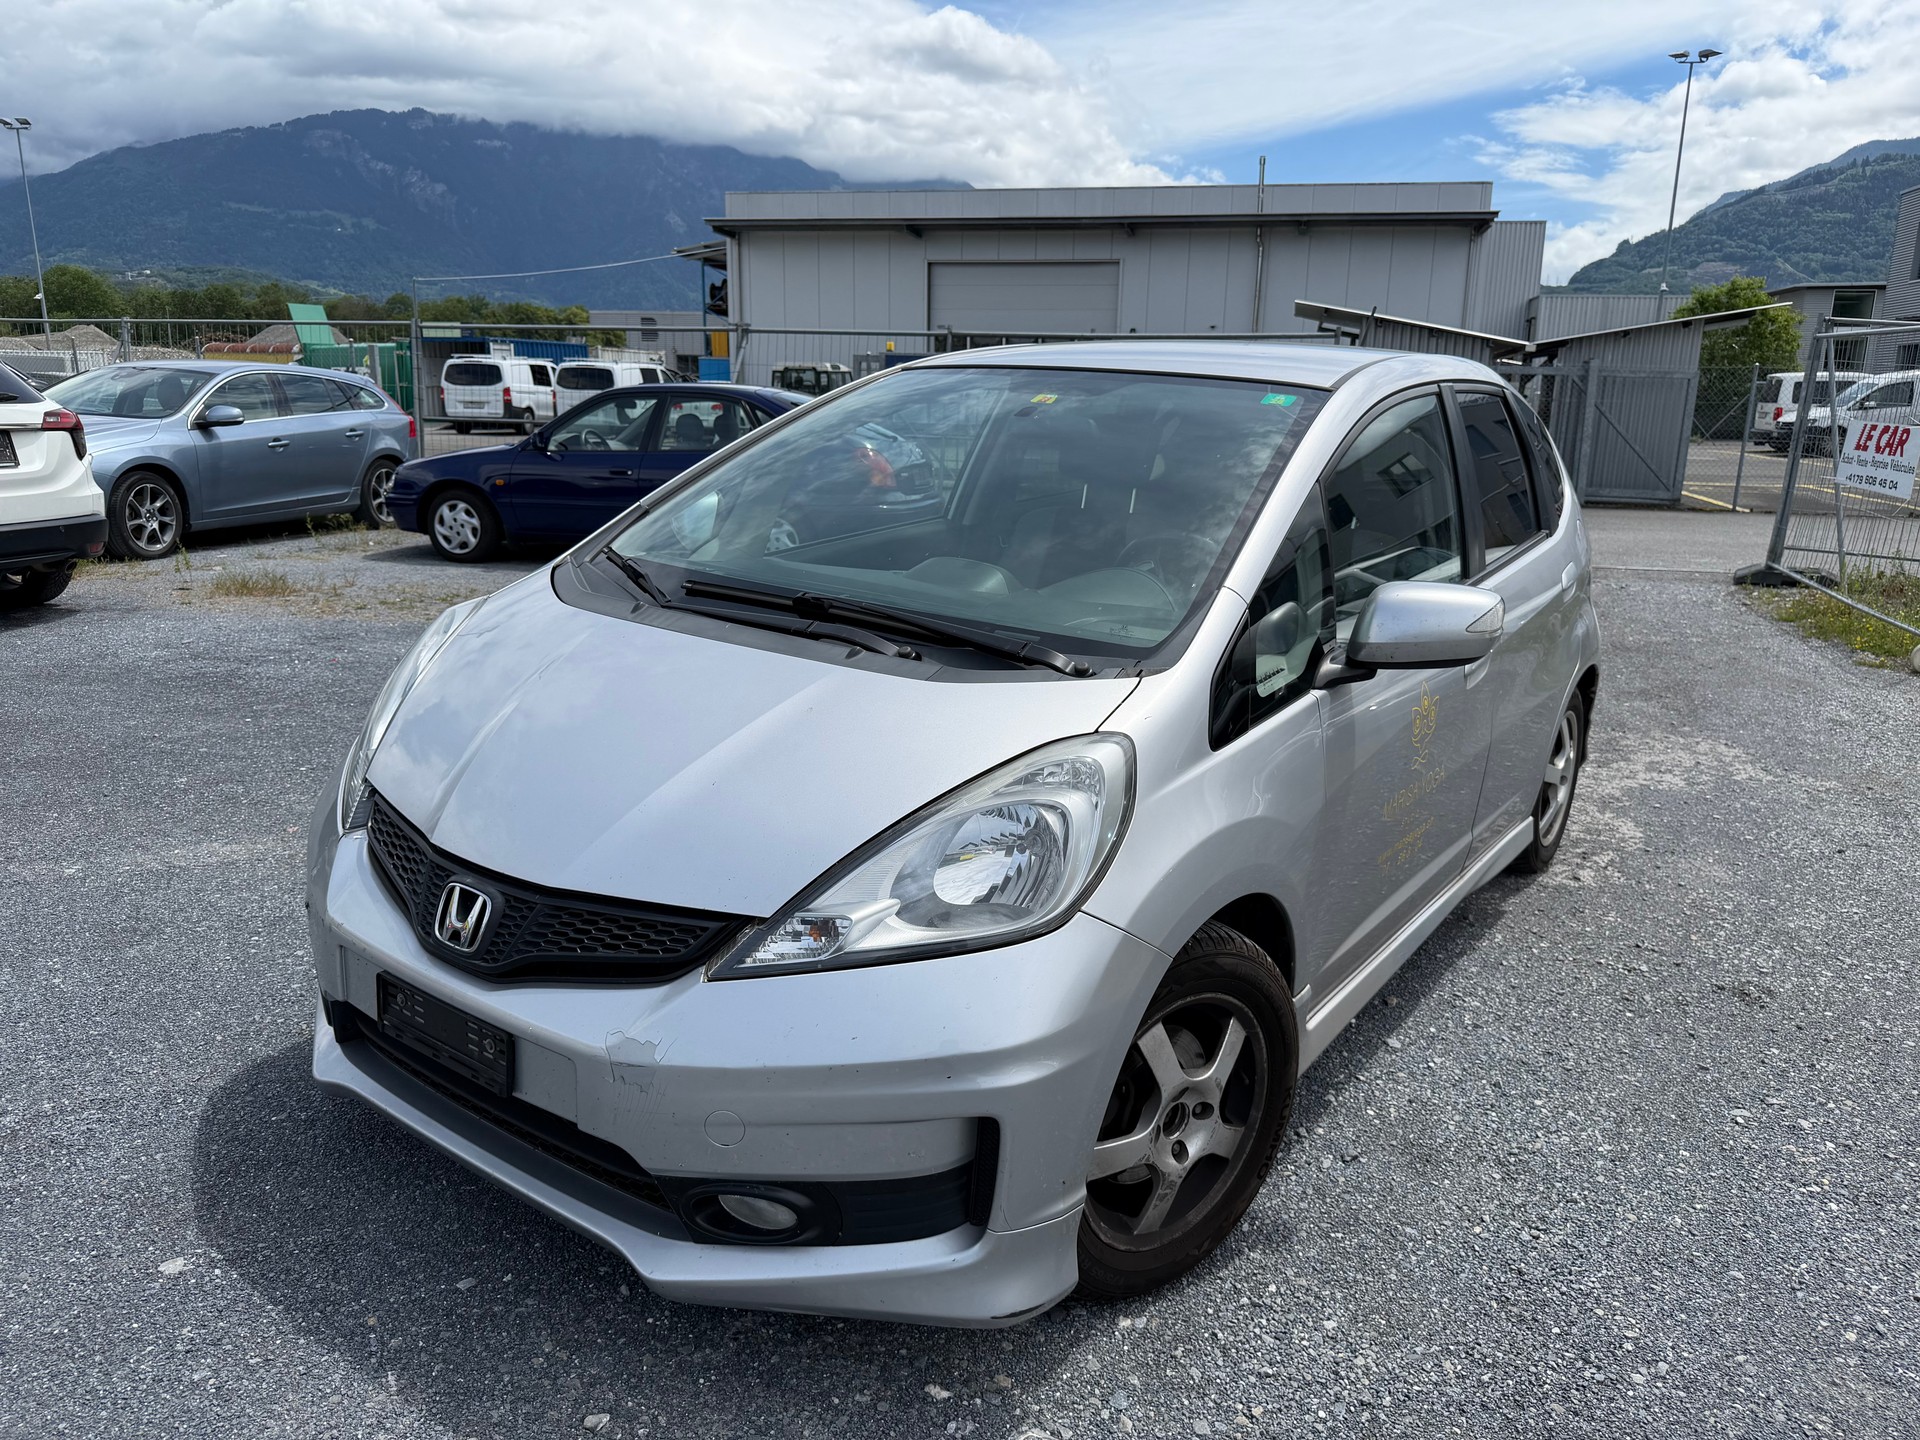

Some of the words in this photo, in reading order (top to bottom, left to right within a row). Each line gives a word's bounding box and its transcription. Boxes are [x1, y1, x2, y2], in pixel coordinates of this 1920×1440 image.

[1854, 423, 1878, 452] LE
[1875, 425, 1911, 457] CAR
[1856, 455, 1868, 467] Vente
[1870, 456, 1889, 471] Reprise
[1878, 478, 1888, 488] 45
[1888, 480, 1898, 490] 04
